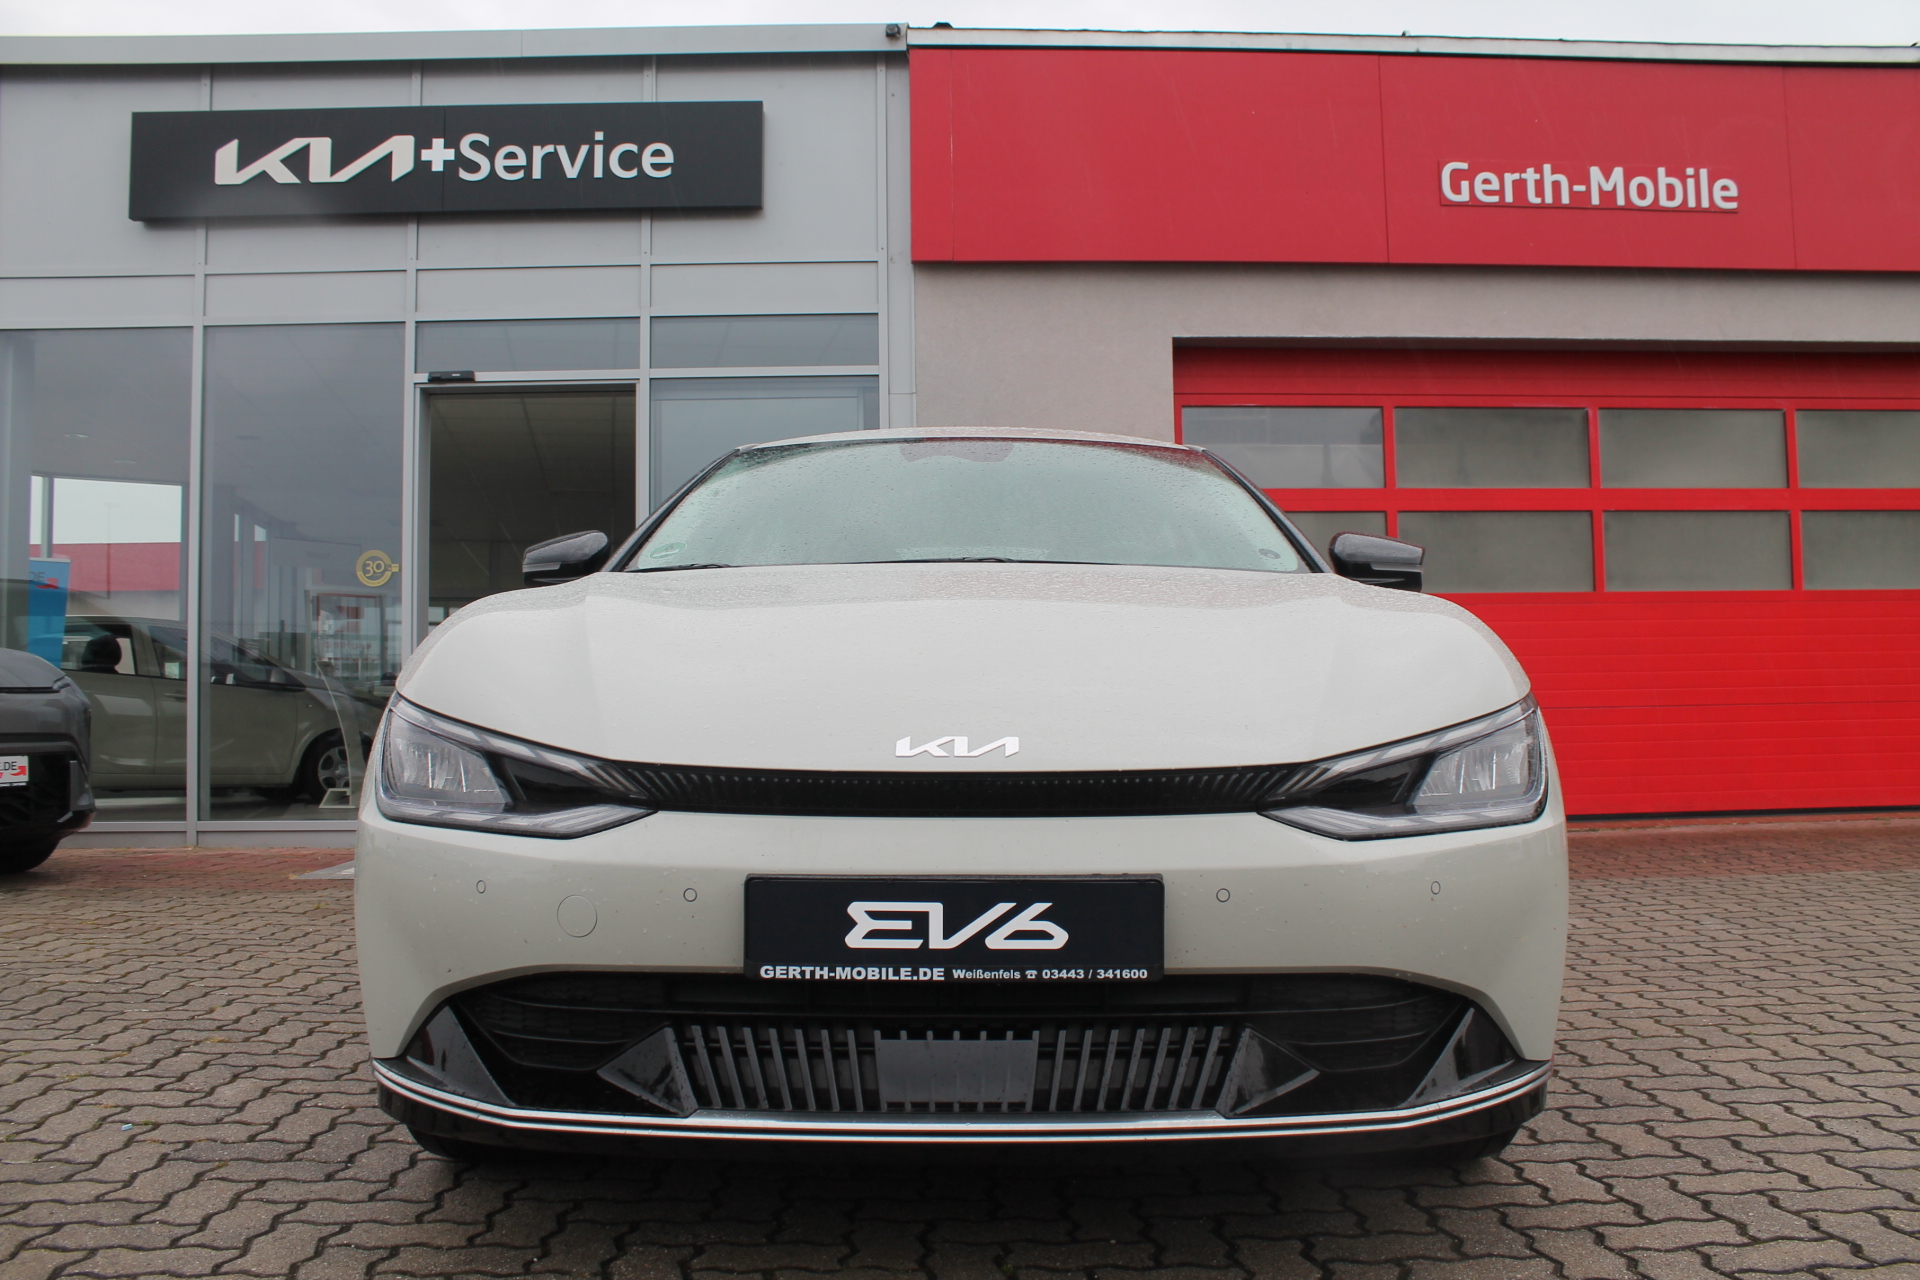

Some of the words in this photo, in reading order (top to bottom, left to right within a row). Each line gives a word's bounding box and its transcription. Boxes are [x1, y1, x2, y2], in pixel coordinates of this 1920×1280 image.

[1441, 161, 1739, 210] Gerth-Mobile
[365, 560, 385, 577] 30
[844, 901, 1069, 950] EV6
[759, 965, 945, 981] GERTH-MOBILE.DE
[952, 968, 1021, 979] Weißenfels
[1042, 969, 1085, 979] 03443
[1096, 969, 1148, 979] 341600
